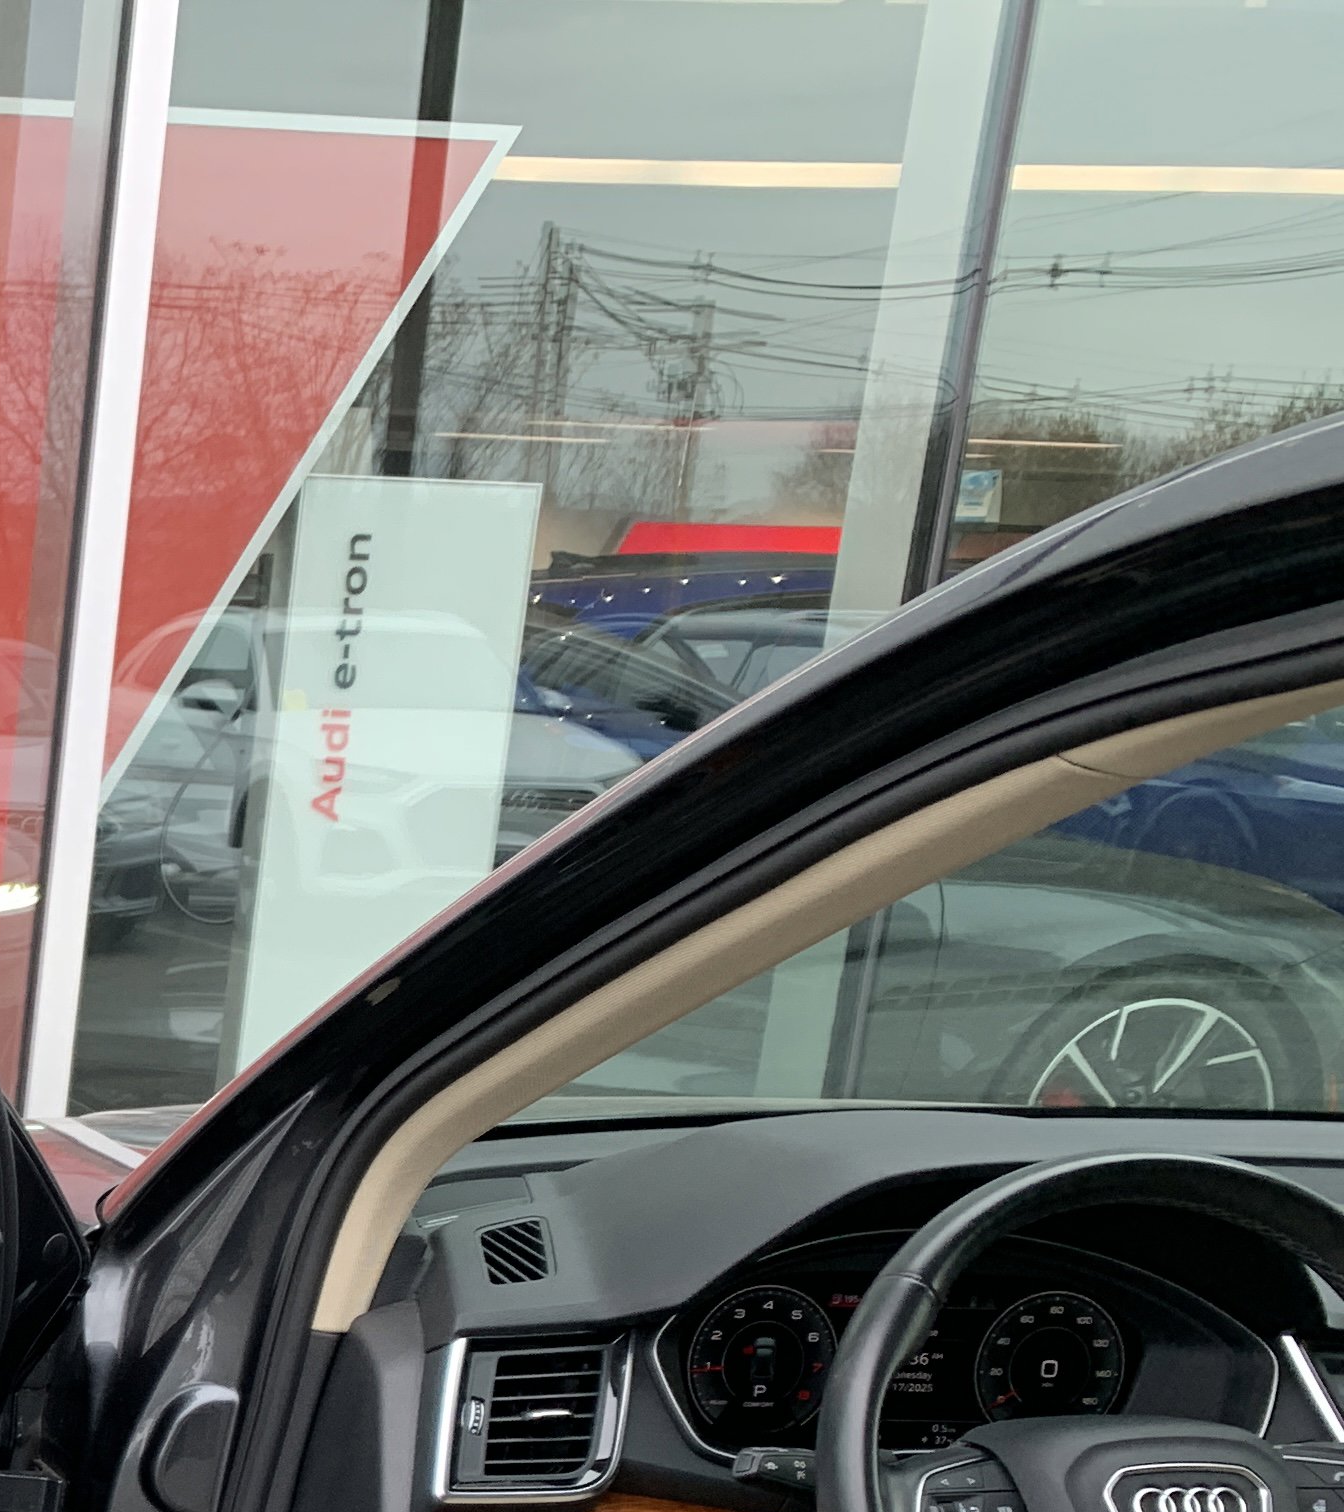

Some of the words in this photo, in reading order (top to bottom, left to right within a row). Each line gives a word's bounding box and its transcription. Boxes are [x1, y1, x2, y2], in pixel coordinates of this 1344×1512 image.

[310, 709, 352, 823] Audi
[334, 533, 372, 690] e-tron
[763, 1301, 774, 1310] 4
[734, 1309, 746, 1319] 3
[791, 1309, 803, 1320] 5
[1020, 1315, 1034, 1324] 60
[1076, 1316, 1093, 1325] 100
[711, 1330, 723, 1341] 2
[808, 1332, 820, 1343] 6
[997, 1337, 1011, 1345] 40
[910, 1352, 930, 1366] 36
[812, 1363, 823, 1373] 7
[990, 1367, 1004, 1376] 20
[1041, 1359, 1059, 1378] 0
[895, 1371, 933, 1382] nesday
[753, 1385, 767, 1397] P
